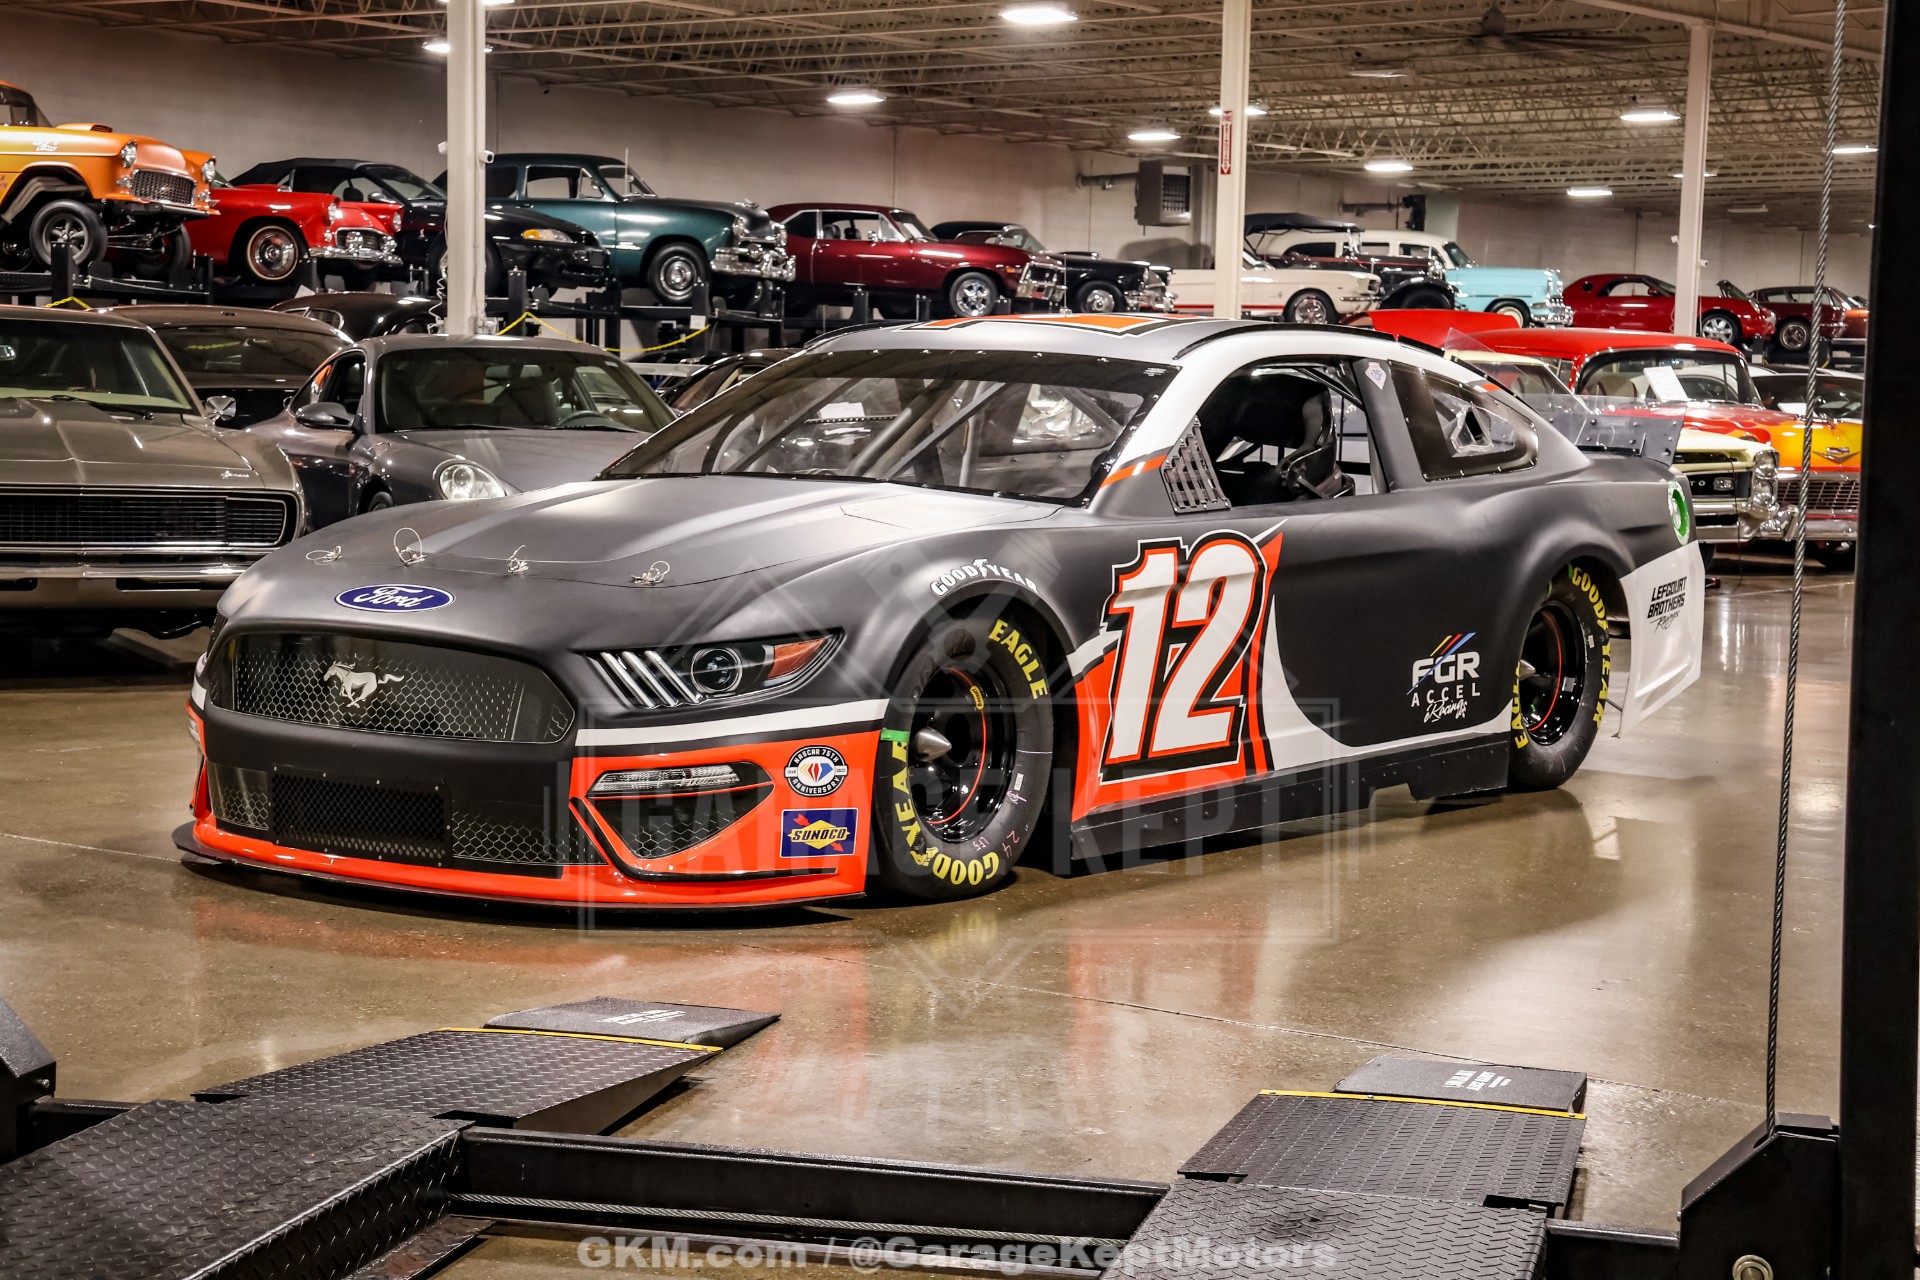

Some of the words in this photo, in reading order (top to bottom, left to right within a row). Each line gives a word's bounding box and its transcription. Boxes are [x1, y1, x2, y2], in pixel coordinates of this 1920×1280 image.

[930, 558, 1040, 596] GOODYEAR
[1651, 576, 1687, 602] LEFCOURT
[353, 586, 435, 608] Ford
[1647, 592, 1686, 619] BROTHERS
[988, 618, 1049, 700] EAGLE
[1100, 532, 1265, 780] 12
[1411, 651, 1480, 688] FGR
[1411, 683, 1481, 708] ACCEL
[793, 748, 820, 764] NASCAR
[821, 748, 840, 763] 75TH
[792, 776, 840, 794] ANNIVERSARY
[792, 828, 847, 841] SUNOCO
